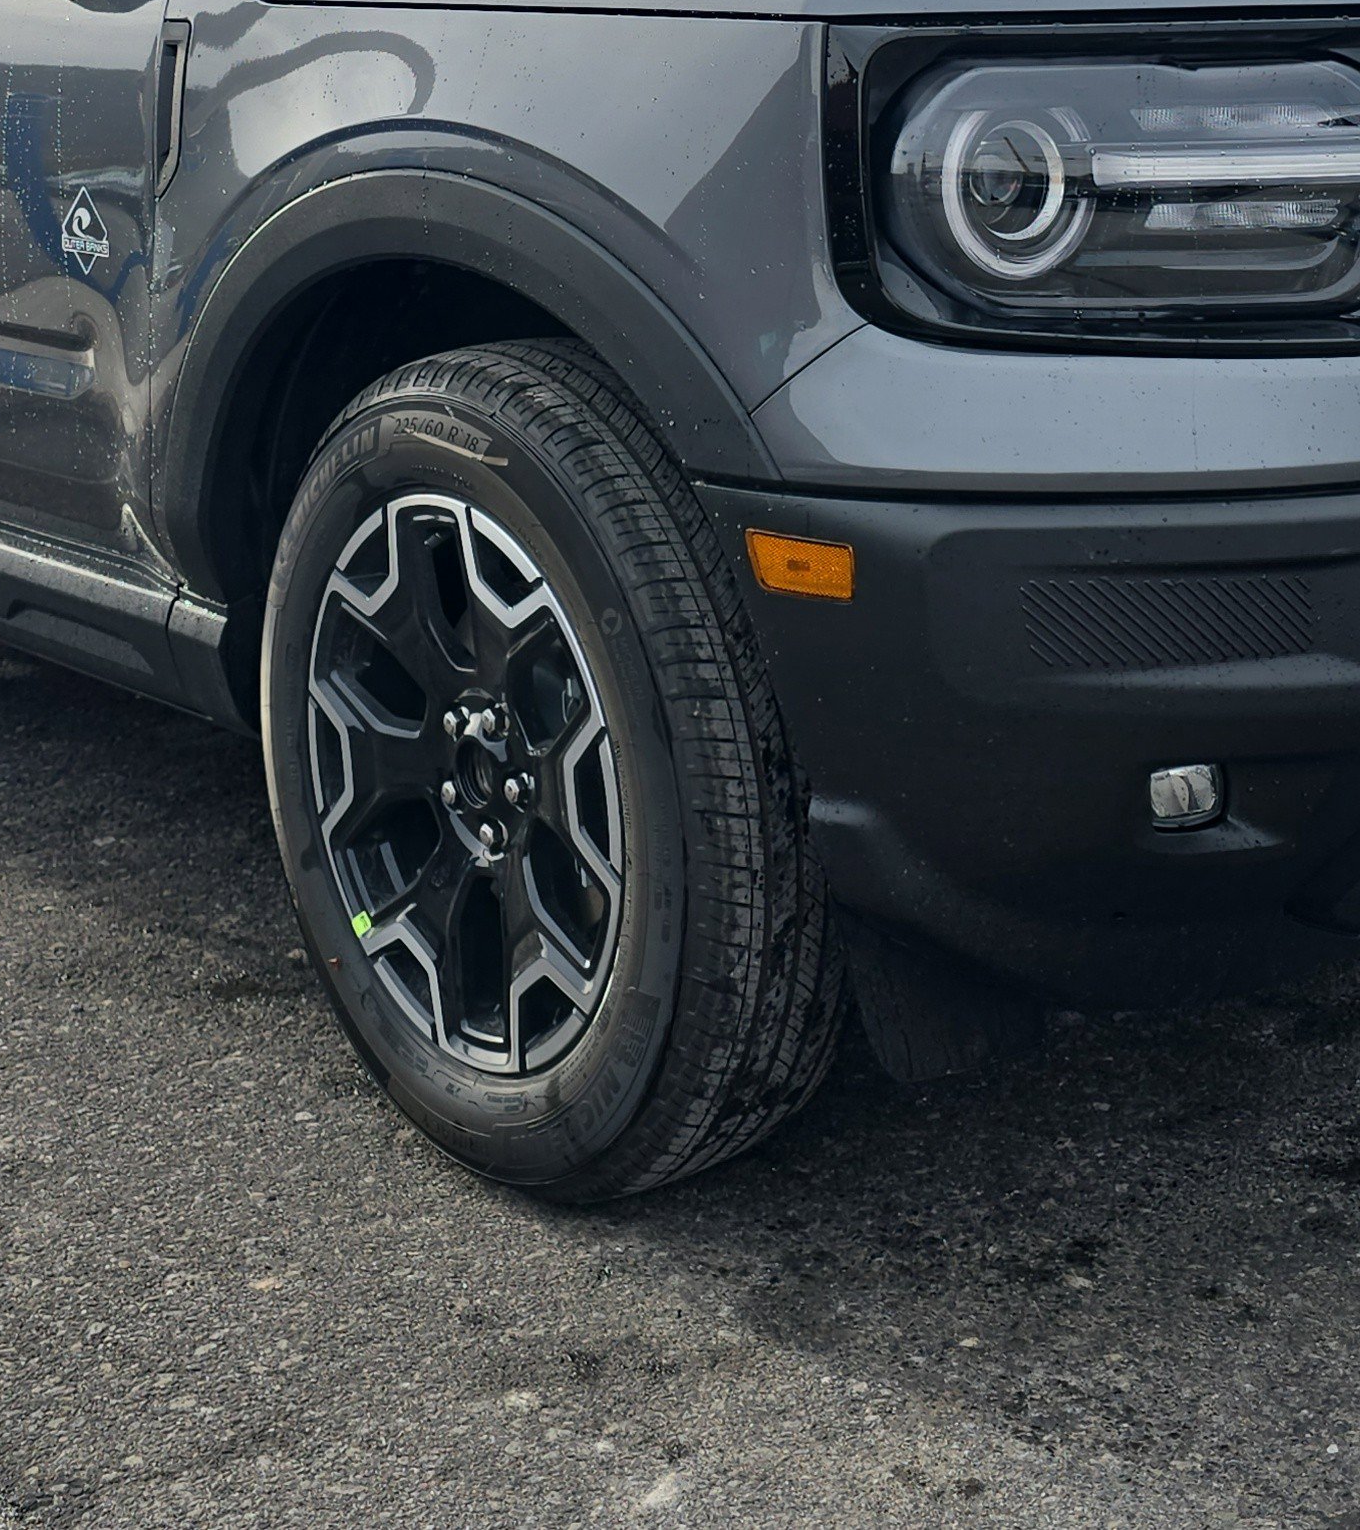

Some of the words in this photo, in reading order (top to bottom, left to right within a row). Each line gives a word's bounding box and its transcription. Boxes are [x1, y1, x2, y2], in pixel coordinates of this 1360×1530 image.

[64, 238, 85, 251] OUTER
[86, 240, 108, 254] BANKS
[393, 417, 444, 437] 225/60
[447, 427, 459, 442] R
[463, 433, 480, 451] 18
[291, 426, 376, 532] MICHELIN
